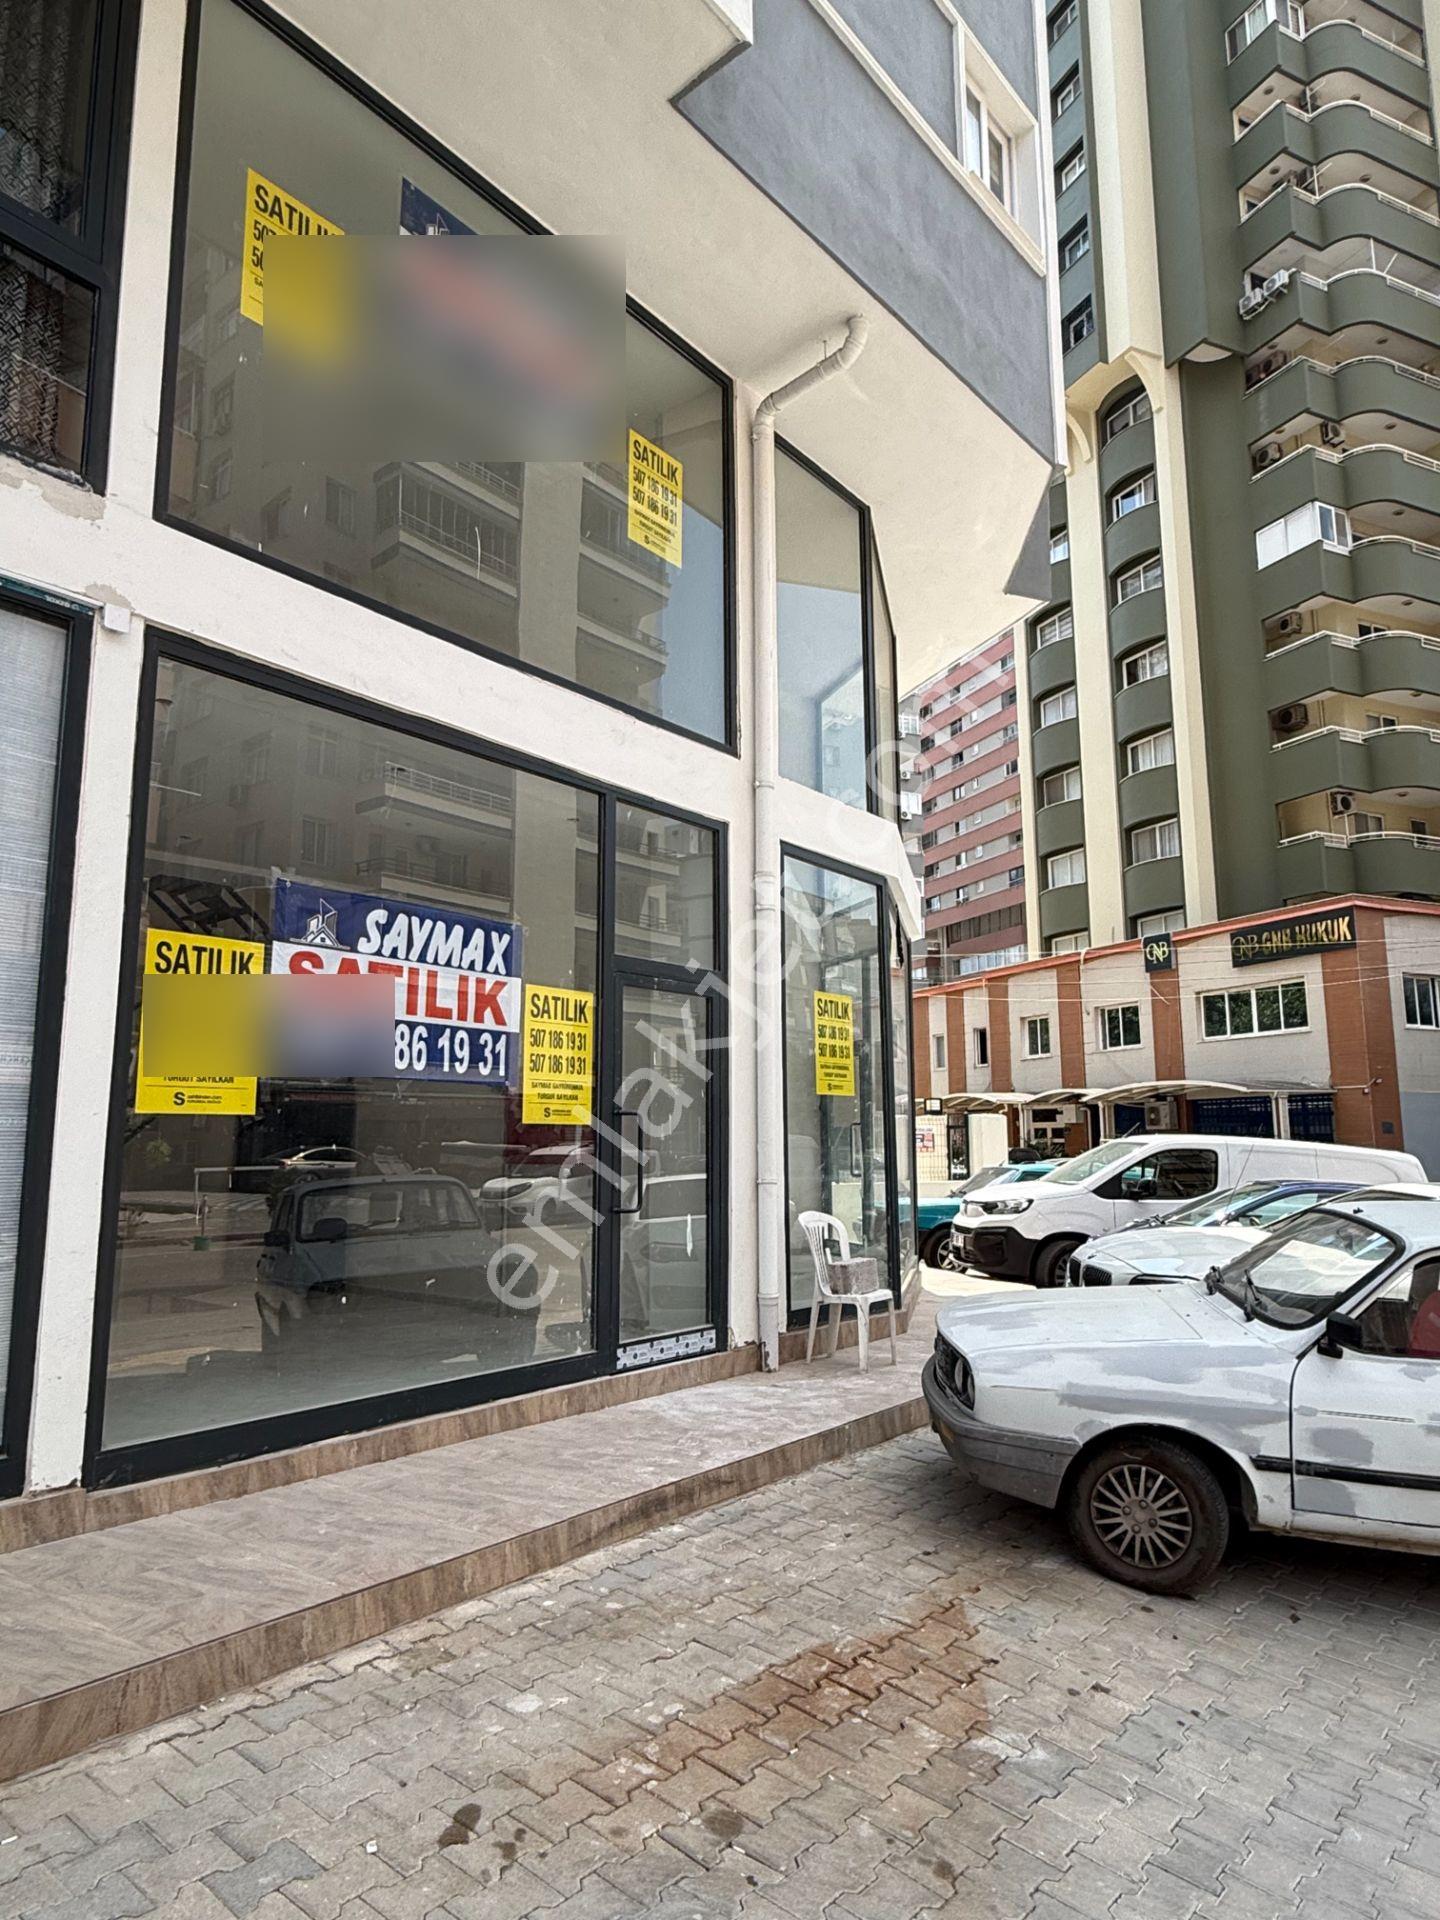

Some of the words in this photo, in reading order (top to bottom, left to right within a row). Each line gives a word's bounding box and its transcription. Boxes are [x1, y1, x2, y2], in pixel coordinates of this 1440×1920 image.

[254, 184, 337, 235] SATIL
[633, 440, 679, 486] SATILIK
[357, 908, 511, 975] SAYMAX
[1295, 916, 1352, 950] HUKUK
[530, 993, 588, 1024] SATILIK
[817, 998, 850, 1021] SATILIK
[438, 1028, 470, 1074] 19
[478, 1032, 507, 1077] 31
[530, 1028, 547, 1048] 507
[548, 1030, 564, 1050] 186
[529, 1053, 546, 1073] 507
[548, 1055, 563, 1074] 186
